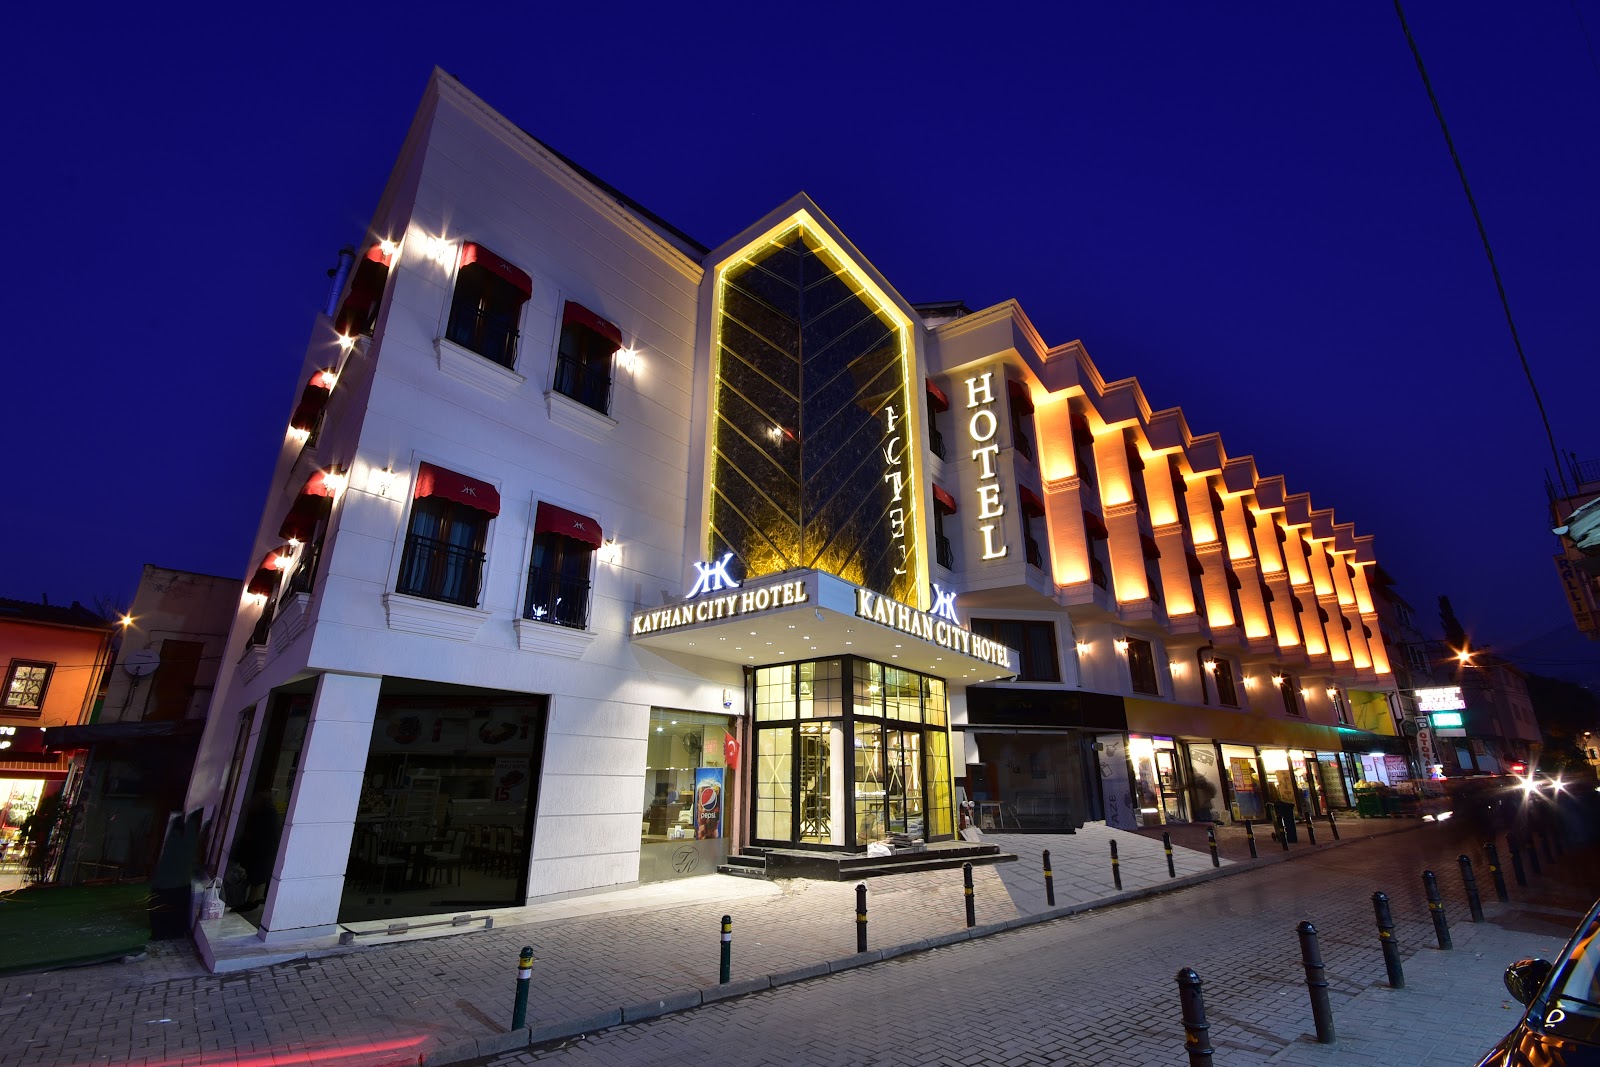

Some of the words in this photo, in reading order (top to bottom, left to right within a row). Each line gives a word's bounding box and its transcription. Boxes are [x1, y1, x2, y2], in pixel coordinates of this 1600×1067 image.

[965, 372, 1008, 562] HOTEL
[632, 604, 694, 635] KAYHAN
[696, 594, 738, 622] CITY
[741, 581, 808, 613] HOTEL
[856, 588, 934, 641] KAYHAN
[936, 622, 970, 653] CITY
[972, 635, 1011, 667] HOTEL
[700, 811, 716, 820] pepsi
